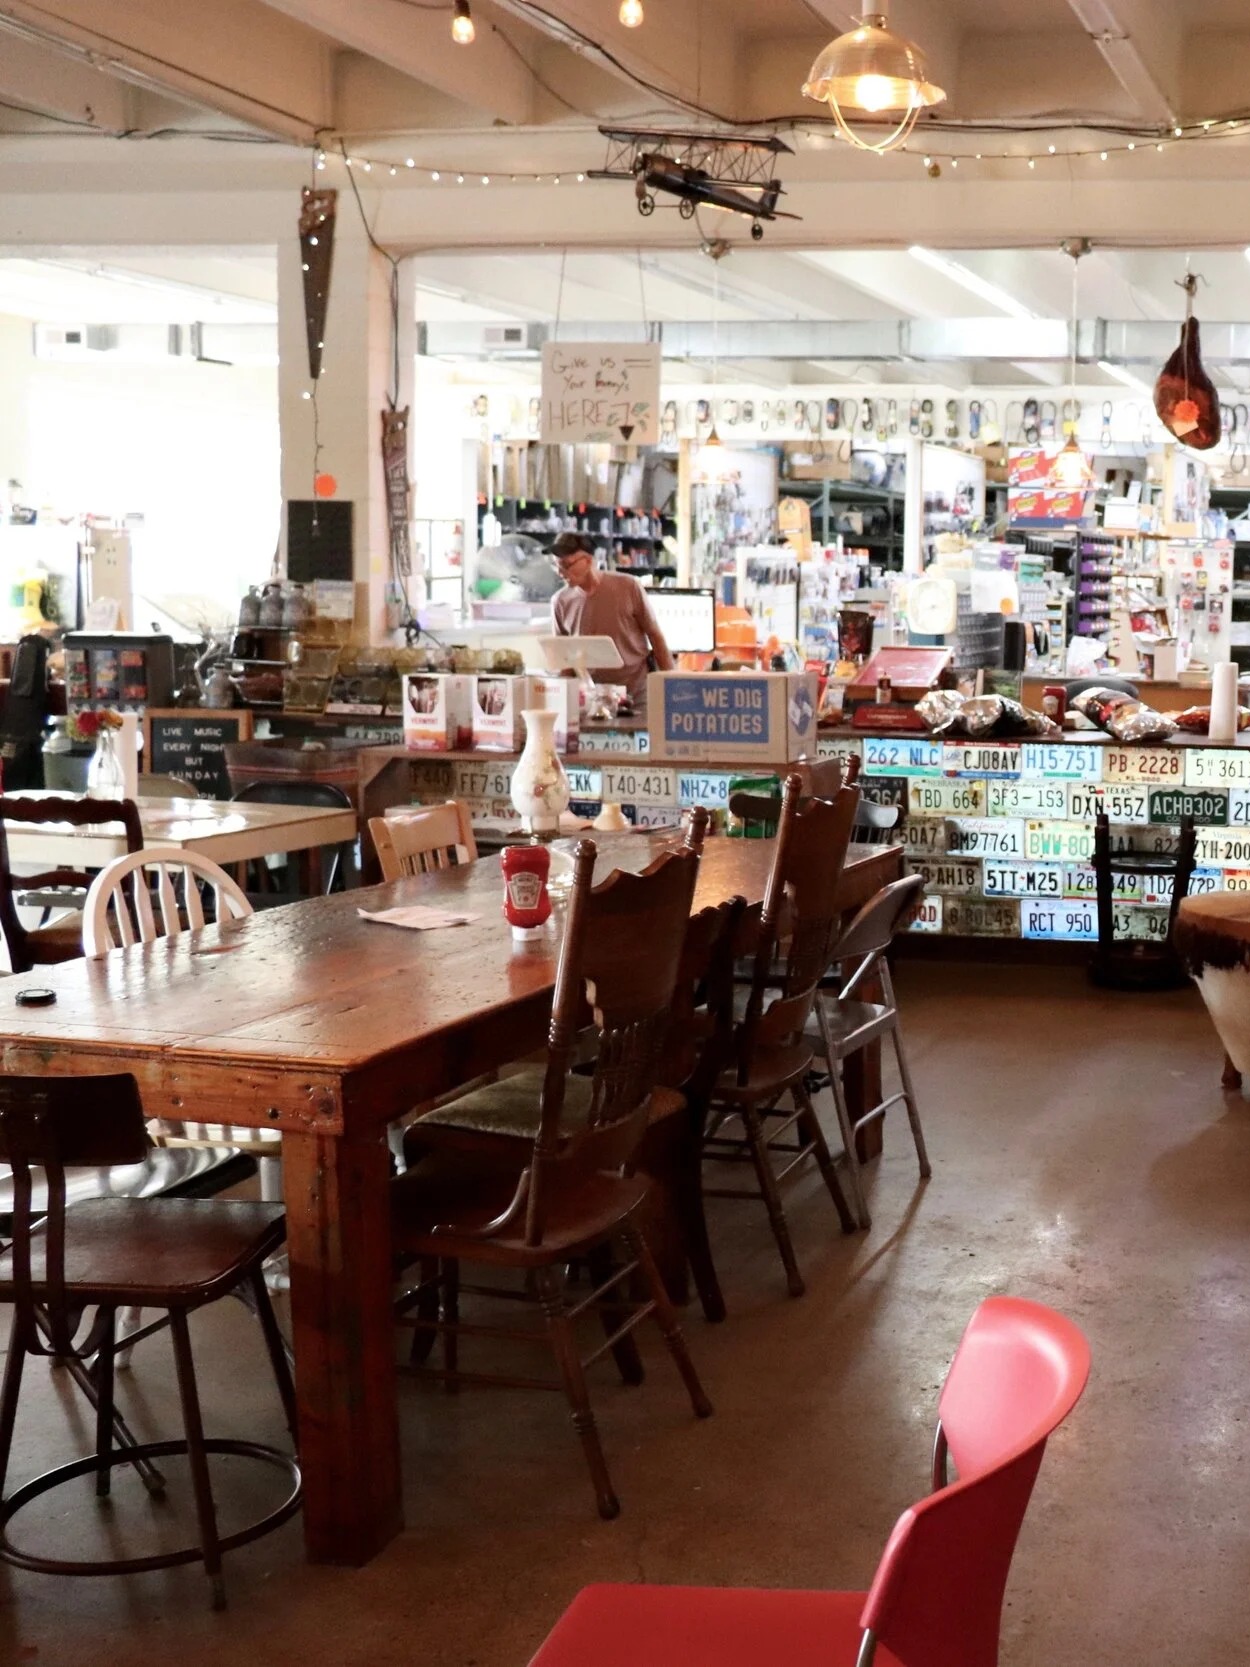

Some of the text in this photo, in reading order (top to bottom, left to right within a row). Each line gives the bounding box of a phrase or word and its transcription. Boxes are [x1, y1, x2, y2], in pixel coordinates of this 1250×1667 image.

[549, 399, 608, 432] HERE
[702, 688, 729, 708] WE
[735, 689, 763, 709] DIG
[162, 728, 222, 737] LIVE MUSIC
[671, 713, 763, 734] POTATOES
[163, 743, 226, 752] EVERY NIGH
[868, 746, 900, 765] 262
[909, 747, 939, 766] NLC
[185, 757, 203, 766] BUT
[169, 771, 219, 780] SUNDAY
[1106, 786, 1131, 794] TEXAS
[1030, 833, 1096, 856] BWW-80
[1029, 912, 1092, 933] RCT 950
